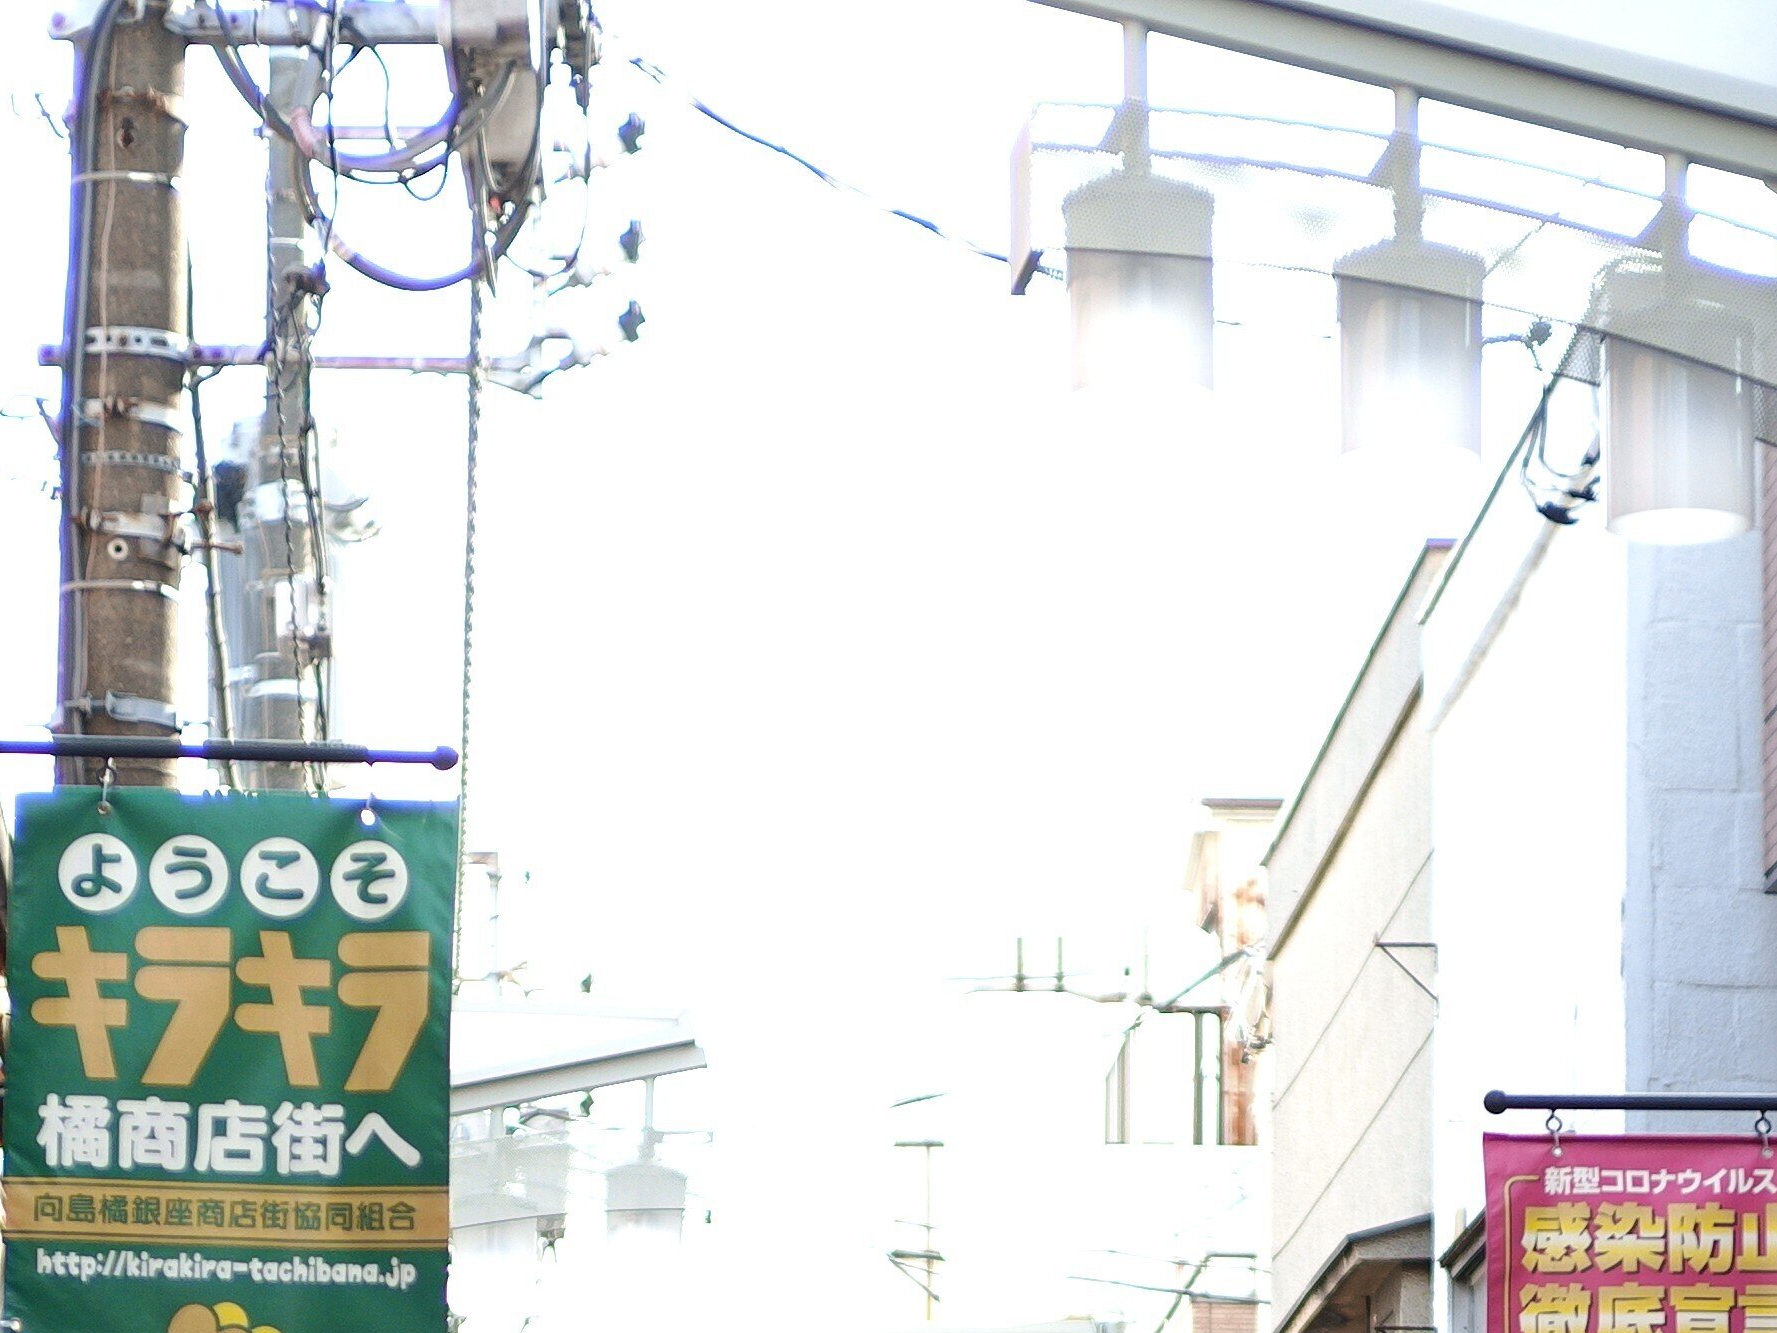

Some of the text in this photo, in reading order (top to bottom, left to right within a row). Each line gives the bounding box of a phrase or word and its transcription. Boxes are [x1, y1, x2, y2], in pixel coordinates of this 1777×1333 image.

[67, 838, 400, 907] ようこそ
[31, 924, 431, 1092] キラキラ
[36, 1093, 422, 1177] 橘商店街へ
[35, 1247, 418, 1291] http://kirakira-tachibana.jp
